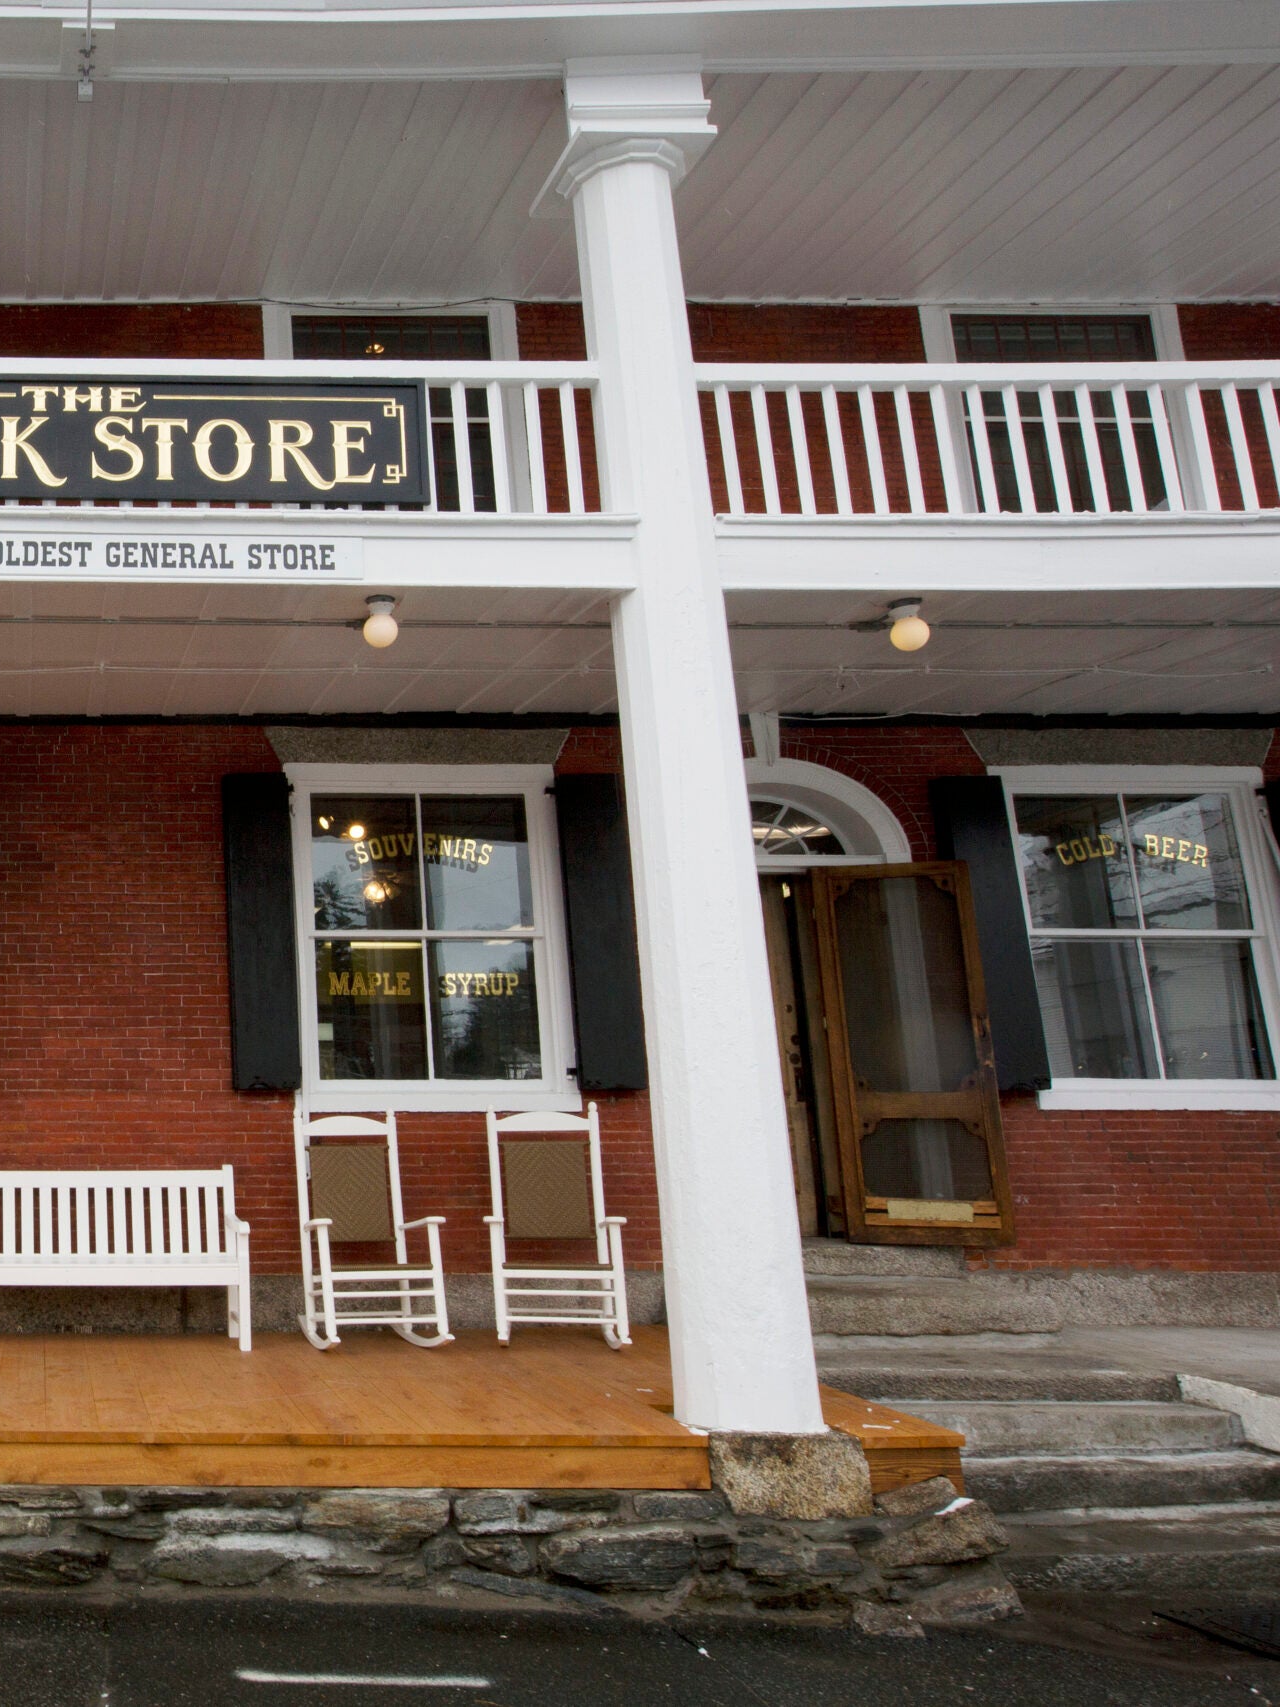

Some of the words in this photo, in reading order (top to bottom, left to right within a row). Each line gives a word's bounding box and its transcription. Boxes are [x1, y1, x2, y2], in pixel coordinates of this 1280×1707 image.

[21, 385, 147, 413] THE
[91, 416, 377, 491] STORE
[105, 541, 234, 569] GENERAL
[248, 543, 336, 571] STORE
[353, 832, 493, 866] SOUVENIRS
[1055, 833, 1116, 866] COLD
[1144, 833, 1209, 868] BEER
[328, 971, 412, 996] MAPLE
[444, 972, 520, 997] SYRUP
